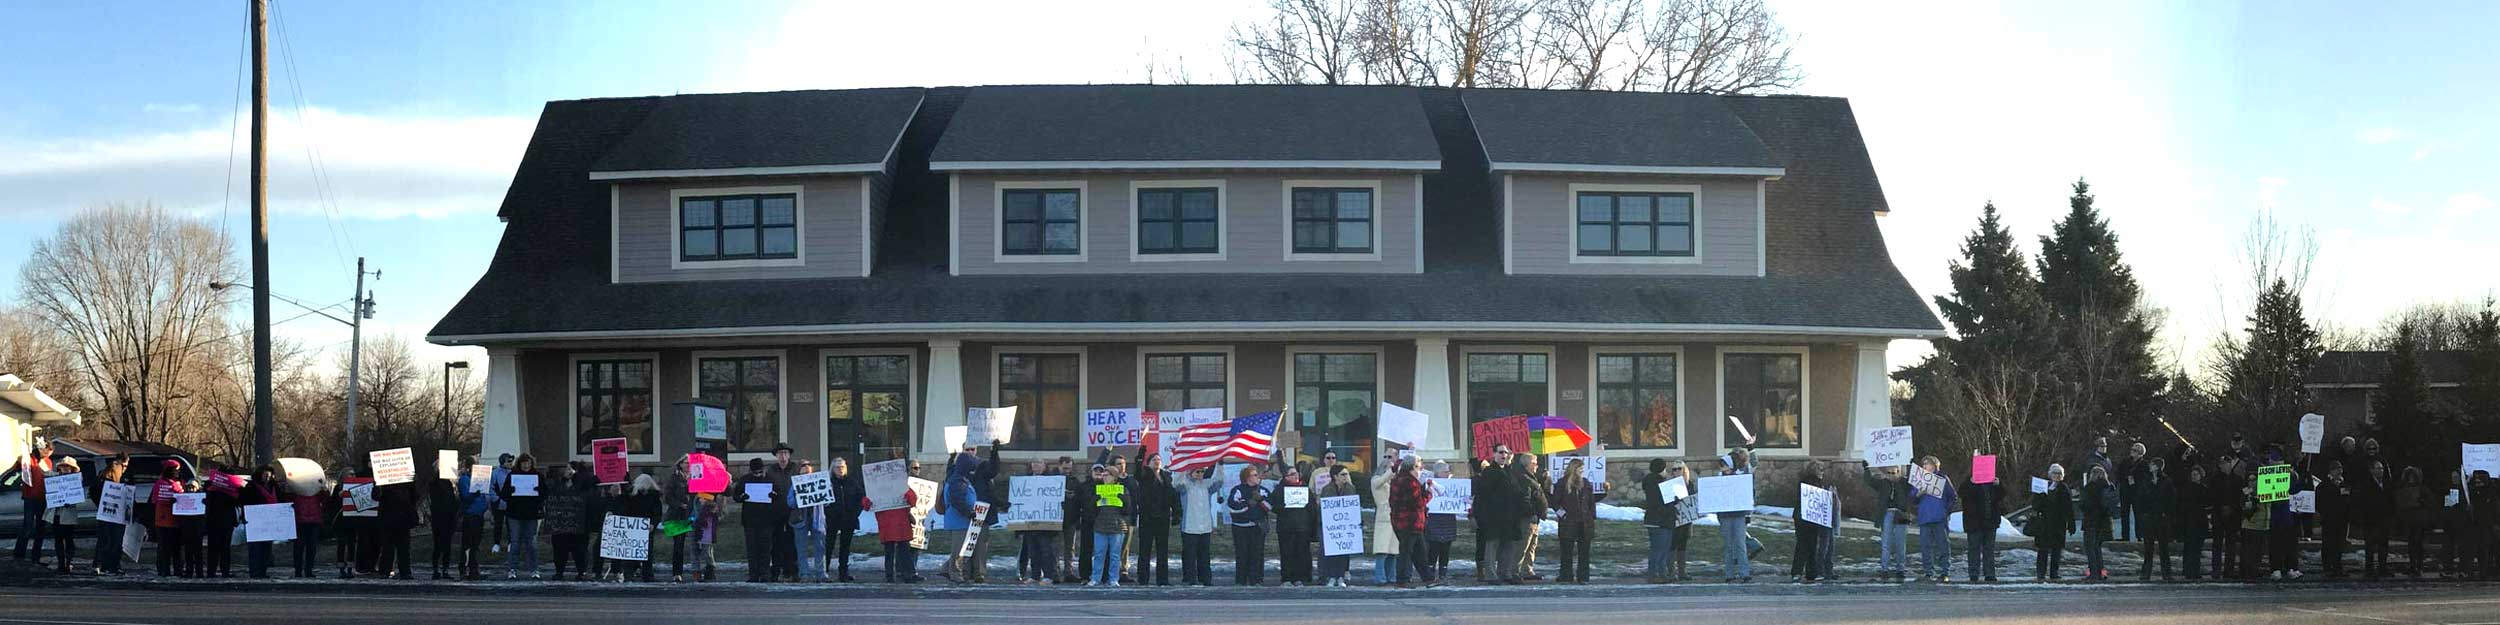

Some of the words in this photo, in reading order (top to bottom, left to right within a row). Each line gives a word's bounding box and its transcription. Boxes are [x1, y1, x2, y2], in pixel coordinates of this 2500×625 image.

[1088, 411, 1126, 425] HEAR
[1088, 429, 1140, 445] VOICE!
[1552, 456, 1604, 470] LEIS
[1916, 466, 1943, 485] NOT
[796, 478, 827, 494] LET'S
[1010, 480, 1032, 498] We
[1037, 481, 1064, 498] need
[800, 489, 834, 505] TALK!
[1803, 485, 1832, 505] JASON
[1013, 503, 1041, 521] Town
[1043, 500, 1064, 520] Hall
[1322, 499, 1341, 510] JASON
[1808, 498, 1829, 514] COME
[613, 516, 649, 531] LEWIS
[1332, 512, 1350, 521] CD2
[1806, 509, 1829, 525] HOME
[607, 529, 628, 539] WEAK
[607, 537, 649, 548] COWARDLY
[606, 546, 649, 559] SPINELESS
